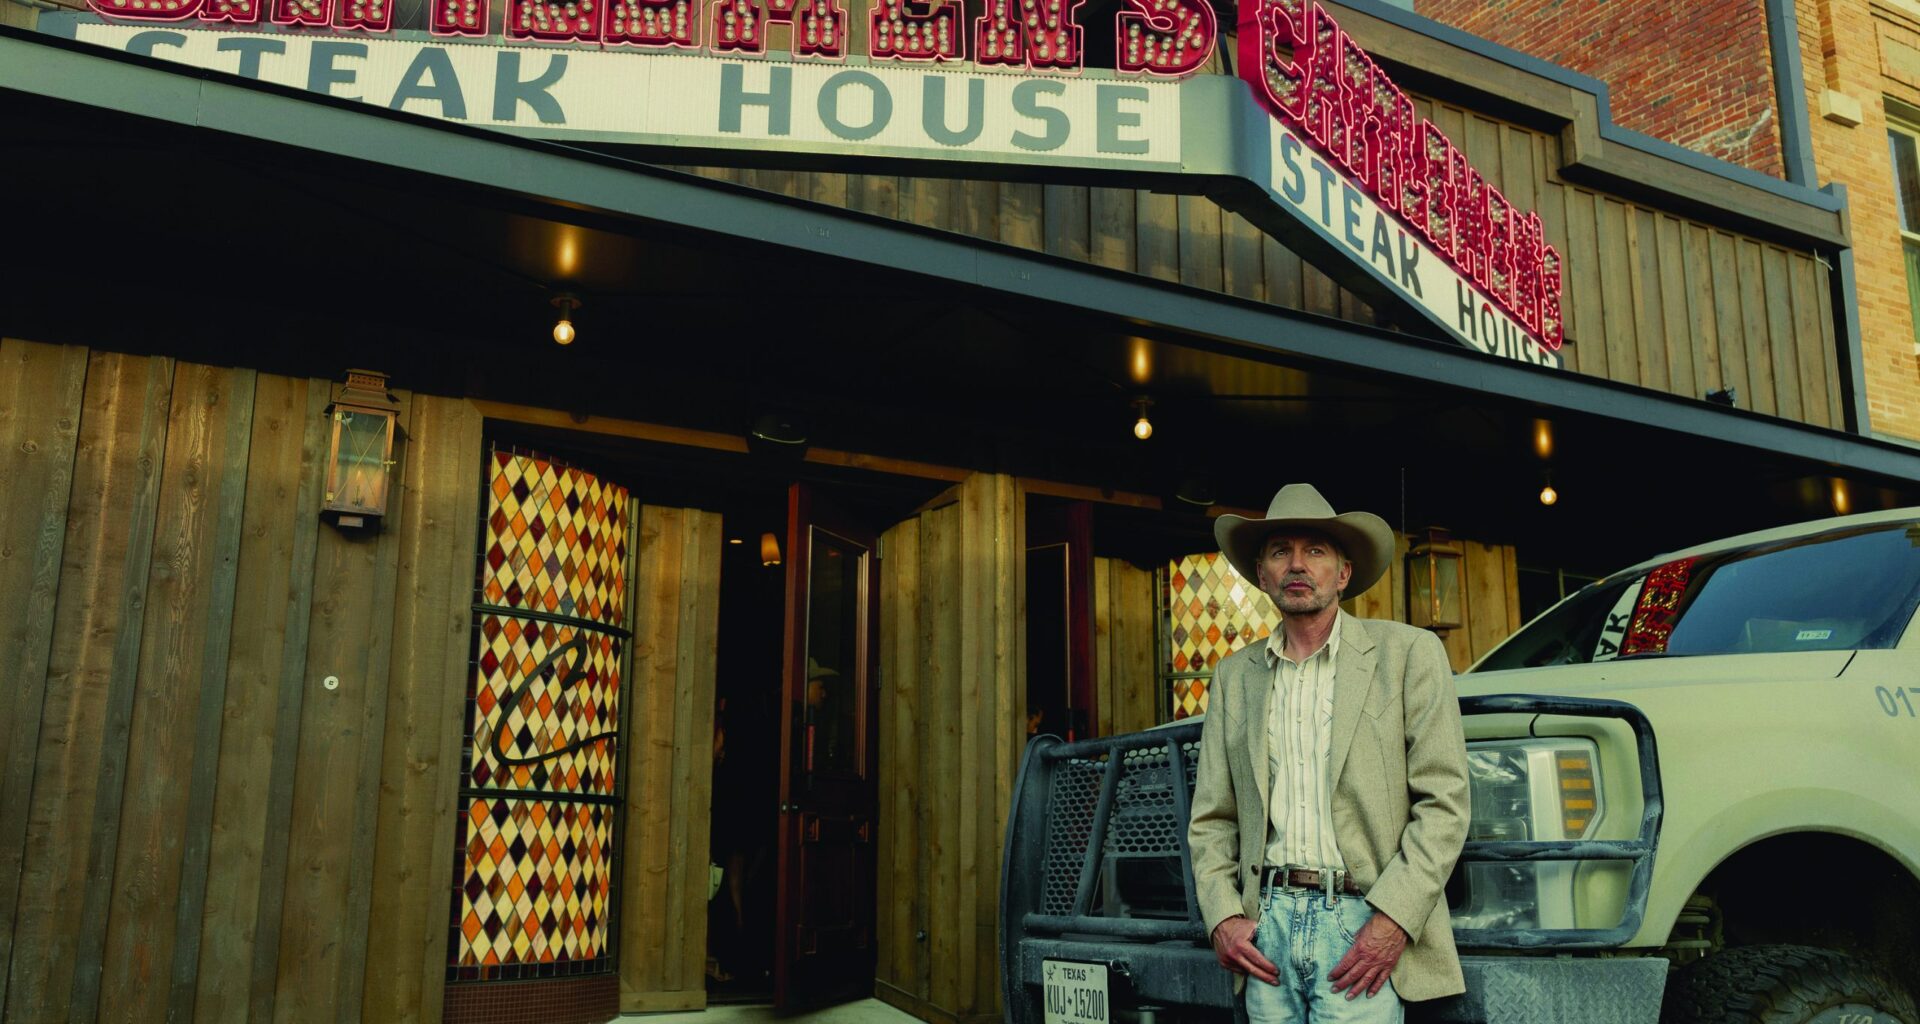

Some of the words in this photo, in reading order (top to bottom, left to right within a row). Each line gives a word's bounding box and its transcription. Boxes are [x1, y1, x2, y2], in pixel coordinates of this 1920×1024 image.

[718, 63, 1150, 155] HOUSE
[1280, 131, 1424, 299] STEAK
[1062, 968, 1087, 981] TEXAS
